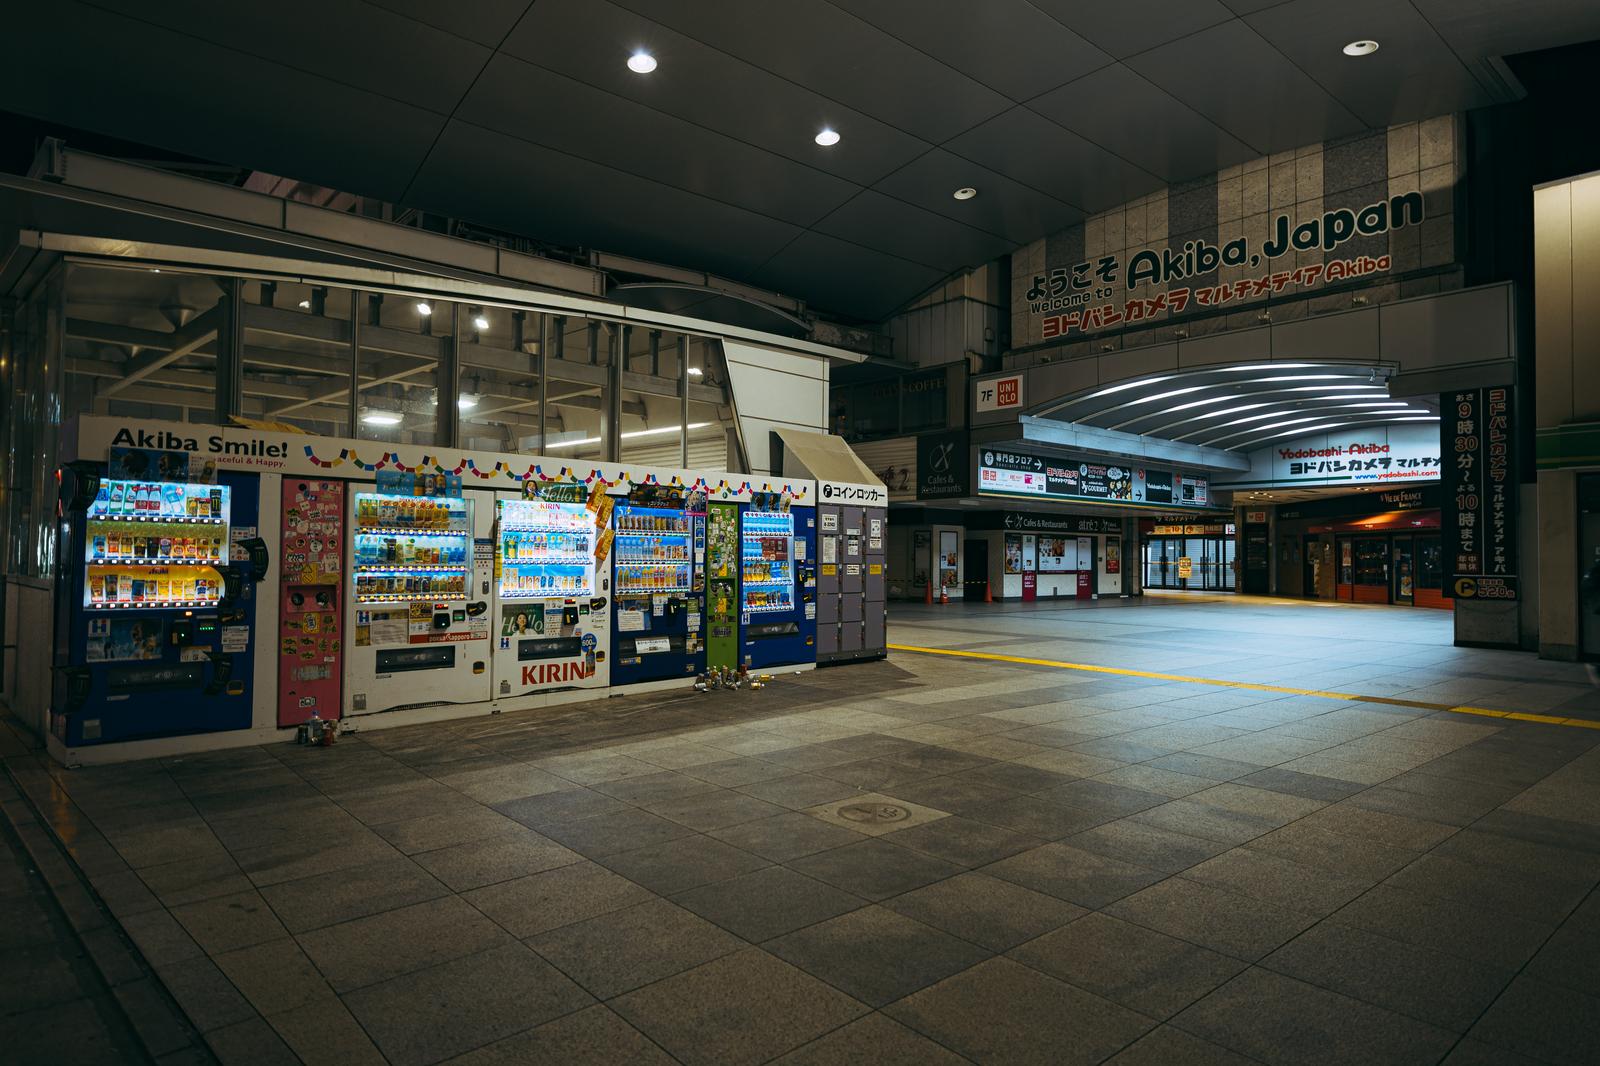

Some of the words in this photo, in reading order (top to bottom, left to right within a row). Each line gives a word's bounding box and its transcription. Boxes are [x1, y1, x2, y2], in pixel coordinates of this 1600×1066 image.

[1263, 189, 1425, 258] Japan
[1026, 256, 1121, 302] ようこそ
[1031, 293, 1091, 315] Welcome
[1094, 286, 1113, 301] to
[1043, 288, 1190, 339] ヨドバシカメラ
[1325, 254, 1391, 283] Akiba
[981, 390, 994, 402] 7F
[999, 381, 1015, 393] UNI
[999, 392, 1016, 405] QLO
[111, 428, 200, 451] Akiba
[208, 436, 288, 458] Smile!
[1488, 389, 1507, 481] ヨドバシカメラ
[256, 458, 287, 468] Happy.
[1279, 443, 1391, 461] Yodobashi-Akiba
[1290, 457, 1392, 476] ヨドバシカメラ
[1355, 469, 1438, 481] www.yodobashi.com
[833, 486, 886, 501] コインロッカー
[1493, 546, 1506, 573] アキバ
[521, 661, 585, 686] KIRIN
